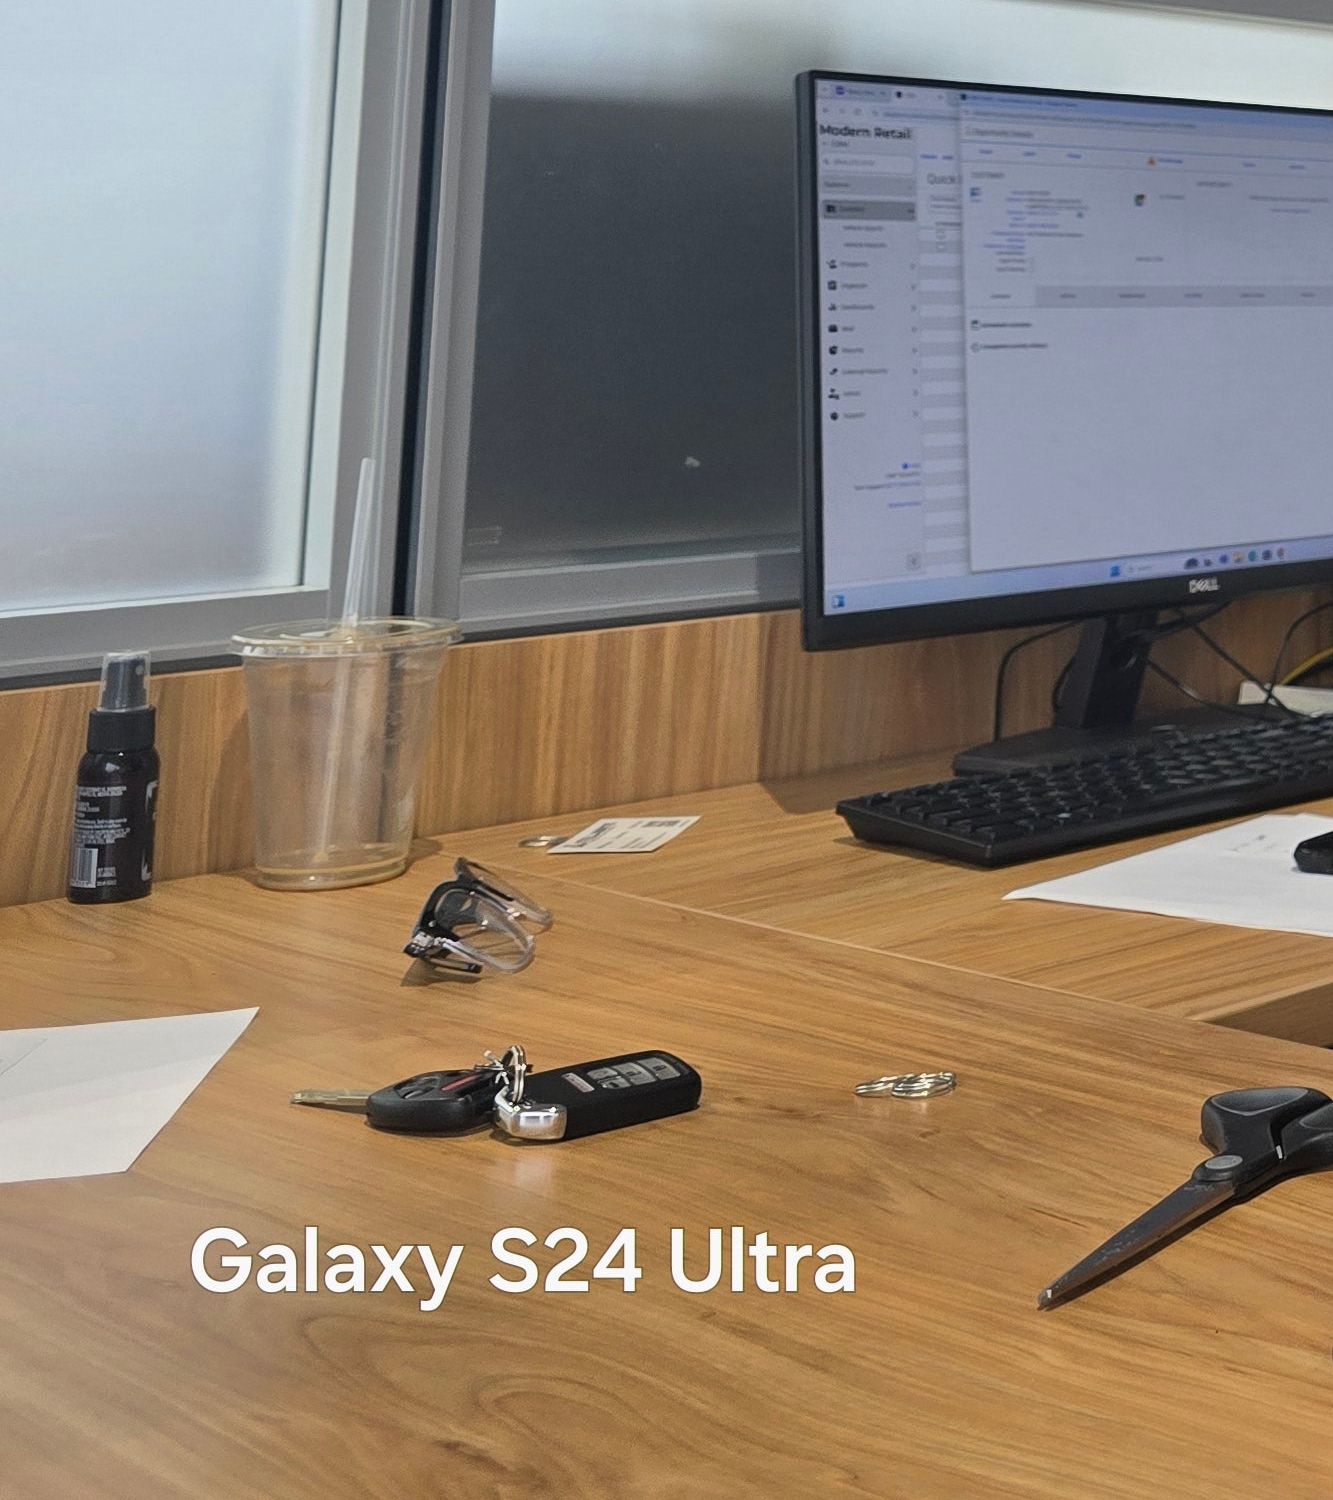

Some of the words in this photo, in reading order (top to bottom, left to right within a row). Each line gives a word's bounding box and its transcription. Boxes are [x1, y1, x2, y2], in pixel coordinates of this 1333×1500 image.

[820, 124, 870, 137] Modern
[874, 127, 912, 140] Retail
[1189, 577, 1220, 593] DELL
